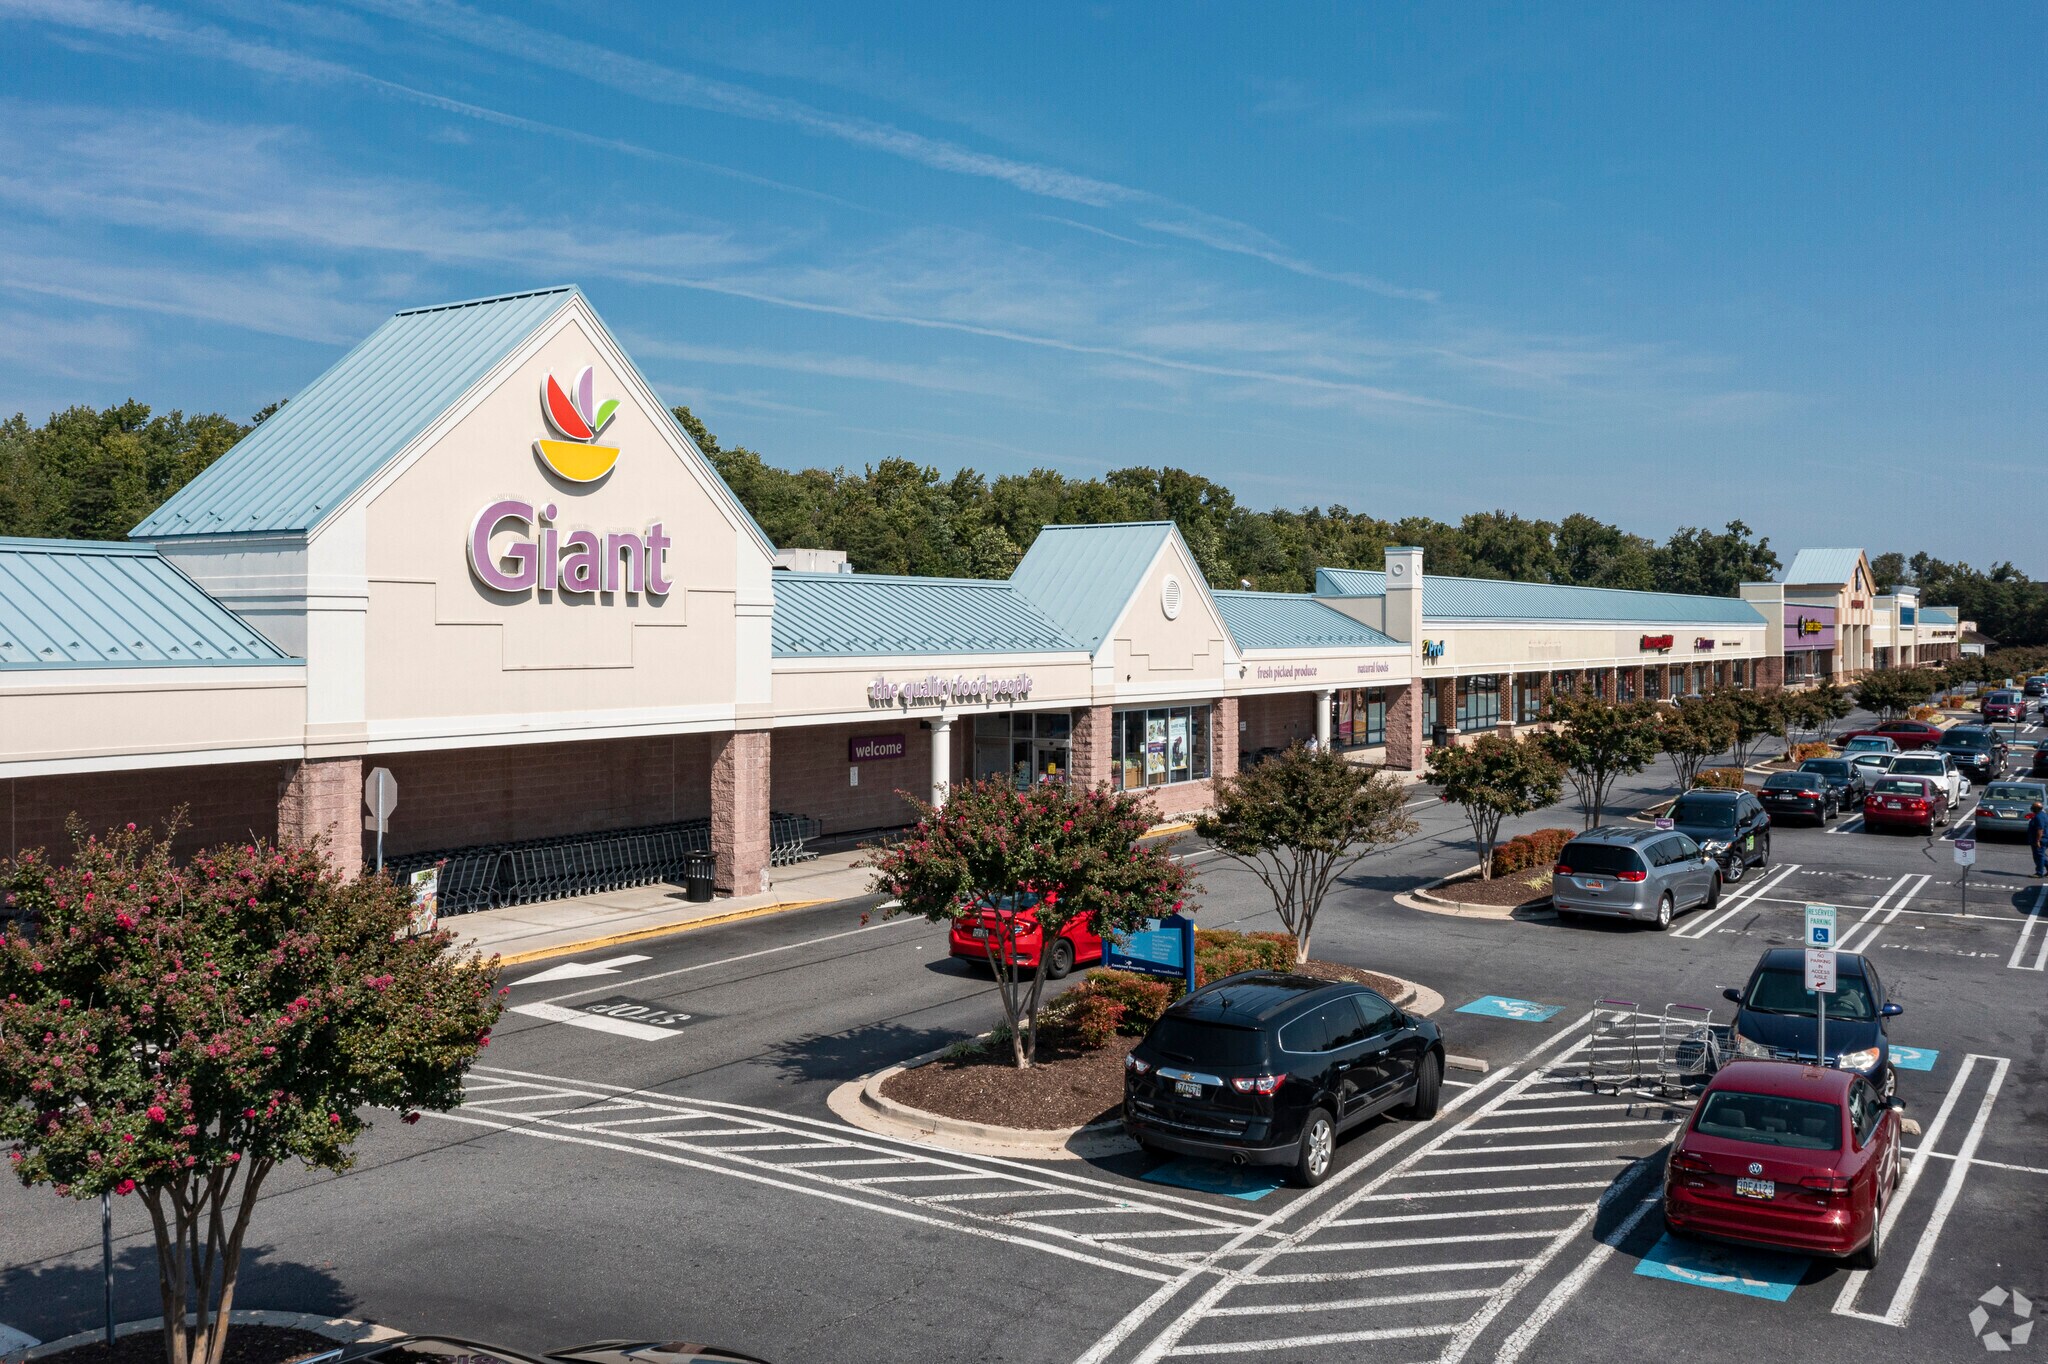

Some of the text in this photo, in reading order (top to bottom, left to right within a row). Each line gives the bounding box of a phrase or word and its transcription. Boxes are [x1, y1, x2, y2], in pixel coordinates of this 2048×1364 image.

[468, 499, 676, 597] Giant
[1257, 664, 1317, 681] fresh picked produce
[1357, 661, 1389, 674] natural foods
[872, 673, 1033, 704] the quality food people
[855, 740, 902, 758] welcome
[1808, 908, 1834, 917] RESERVED
[1810, 917, 1832, 926] PARKING
[586, 1003, 692, 1025] STOP
